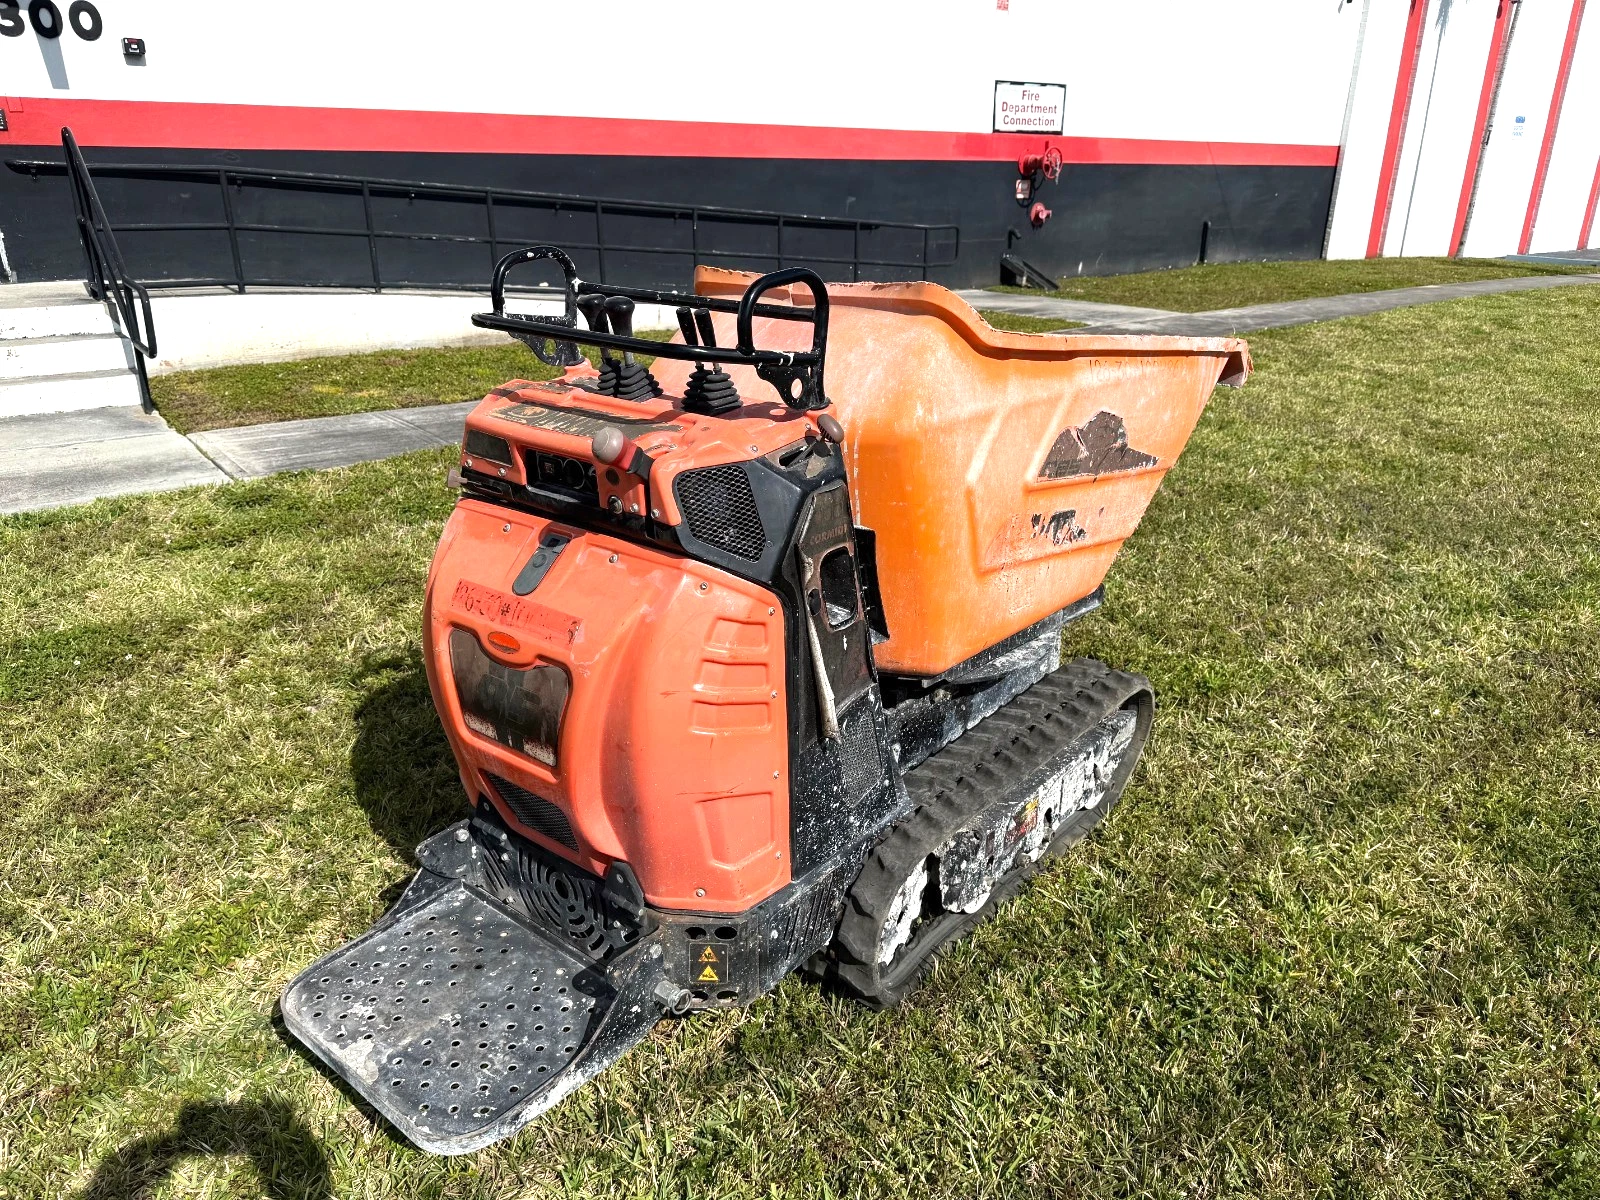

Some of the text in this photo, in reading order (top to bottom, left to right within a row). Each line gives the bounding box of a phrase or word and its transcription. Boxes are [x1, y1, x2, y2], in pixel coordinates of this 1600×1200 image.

[0, 0, 102, 41] 300
[1022, 89, 1040, 101] Fire
[1002, 101, 1057, 115] Department
[1003, 115, 1055, 126] Connection
